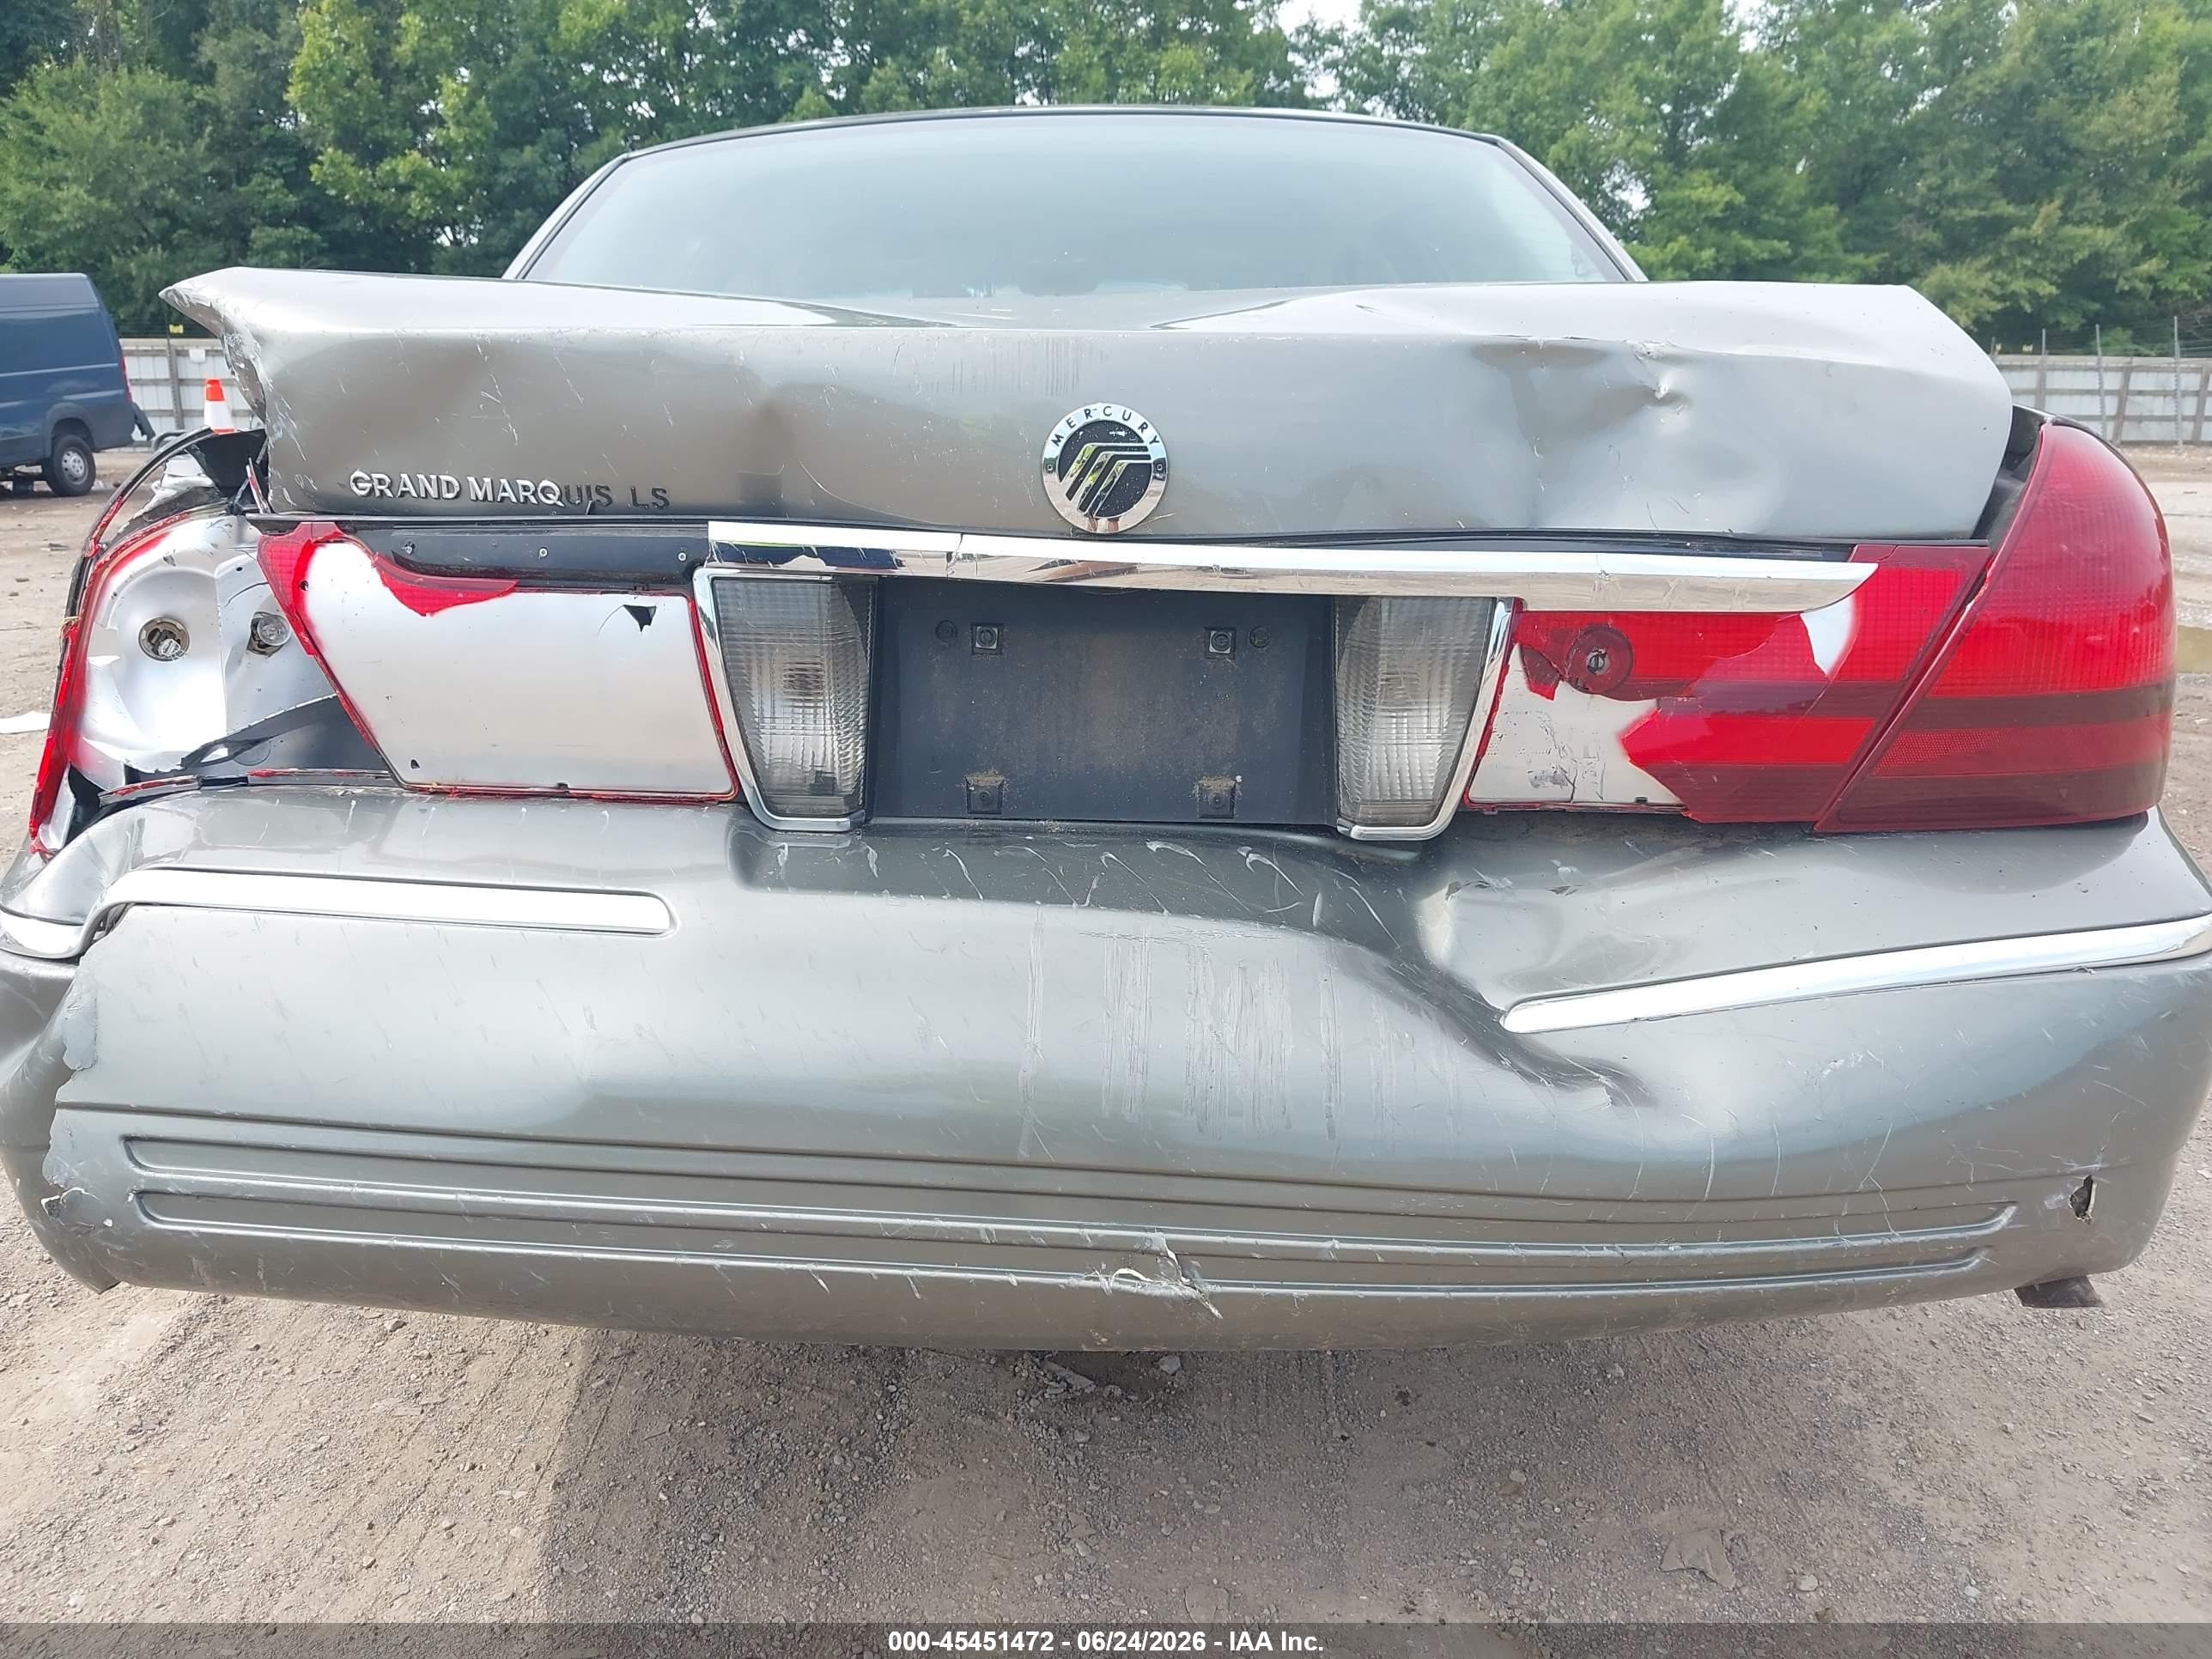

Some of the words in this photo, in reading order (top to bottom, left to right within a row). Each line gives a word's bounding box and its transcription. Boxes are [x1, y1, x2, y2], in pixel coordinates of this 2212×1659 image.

[1050, 405, 1161, 447] MERCURY
[349, 470, 461, 501] GRAND
[466, 475, 614, 507] MARQUIS
[630, 486, 671, 510] LS
